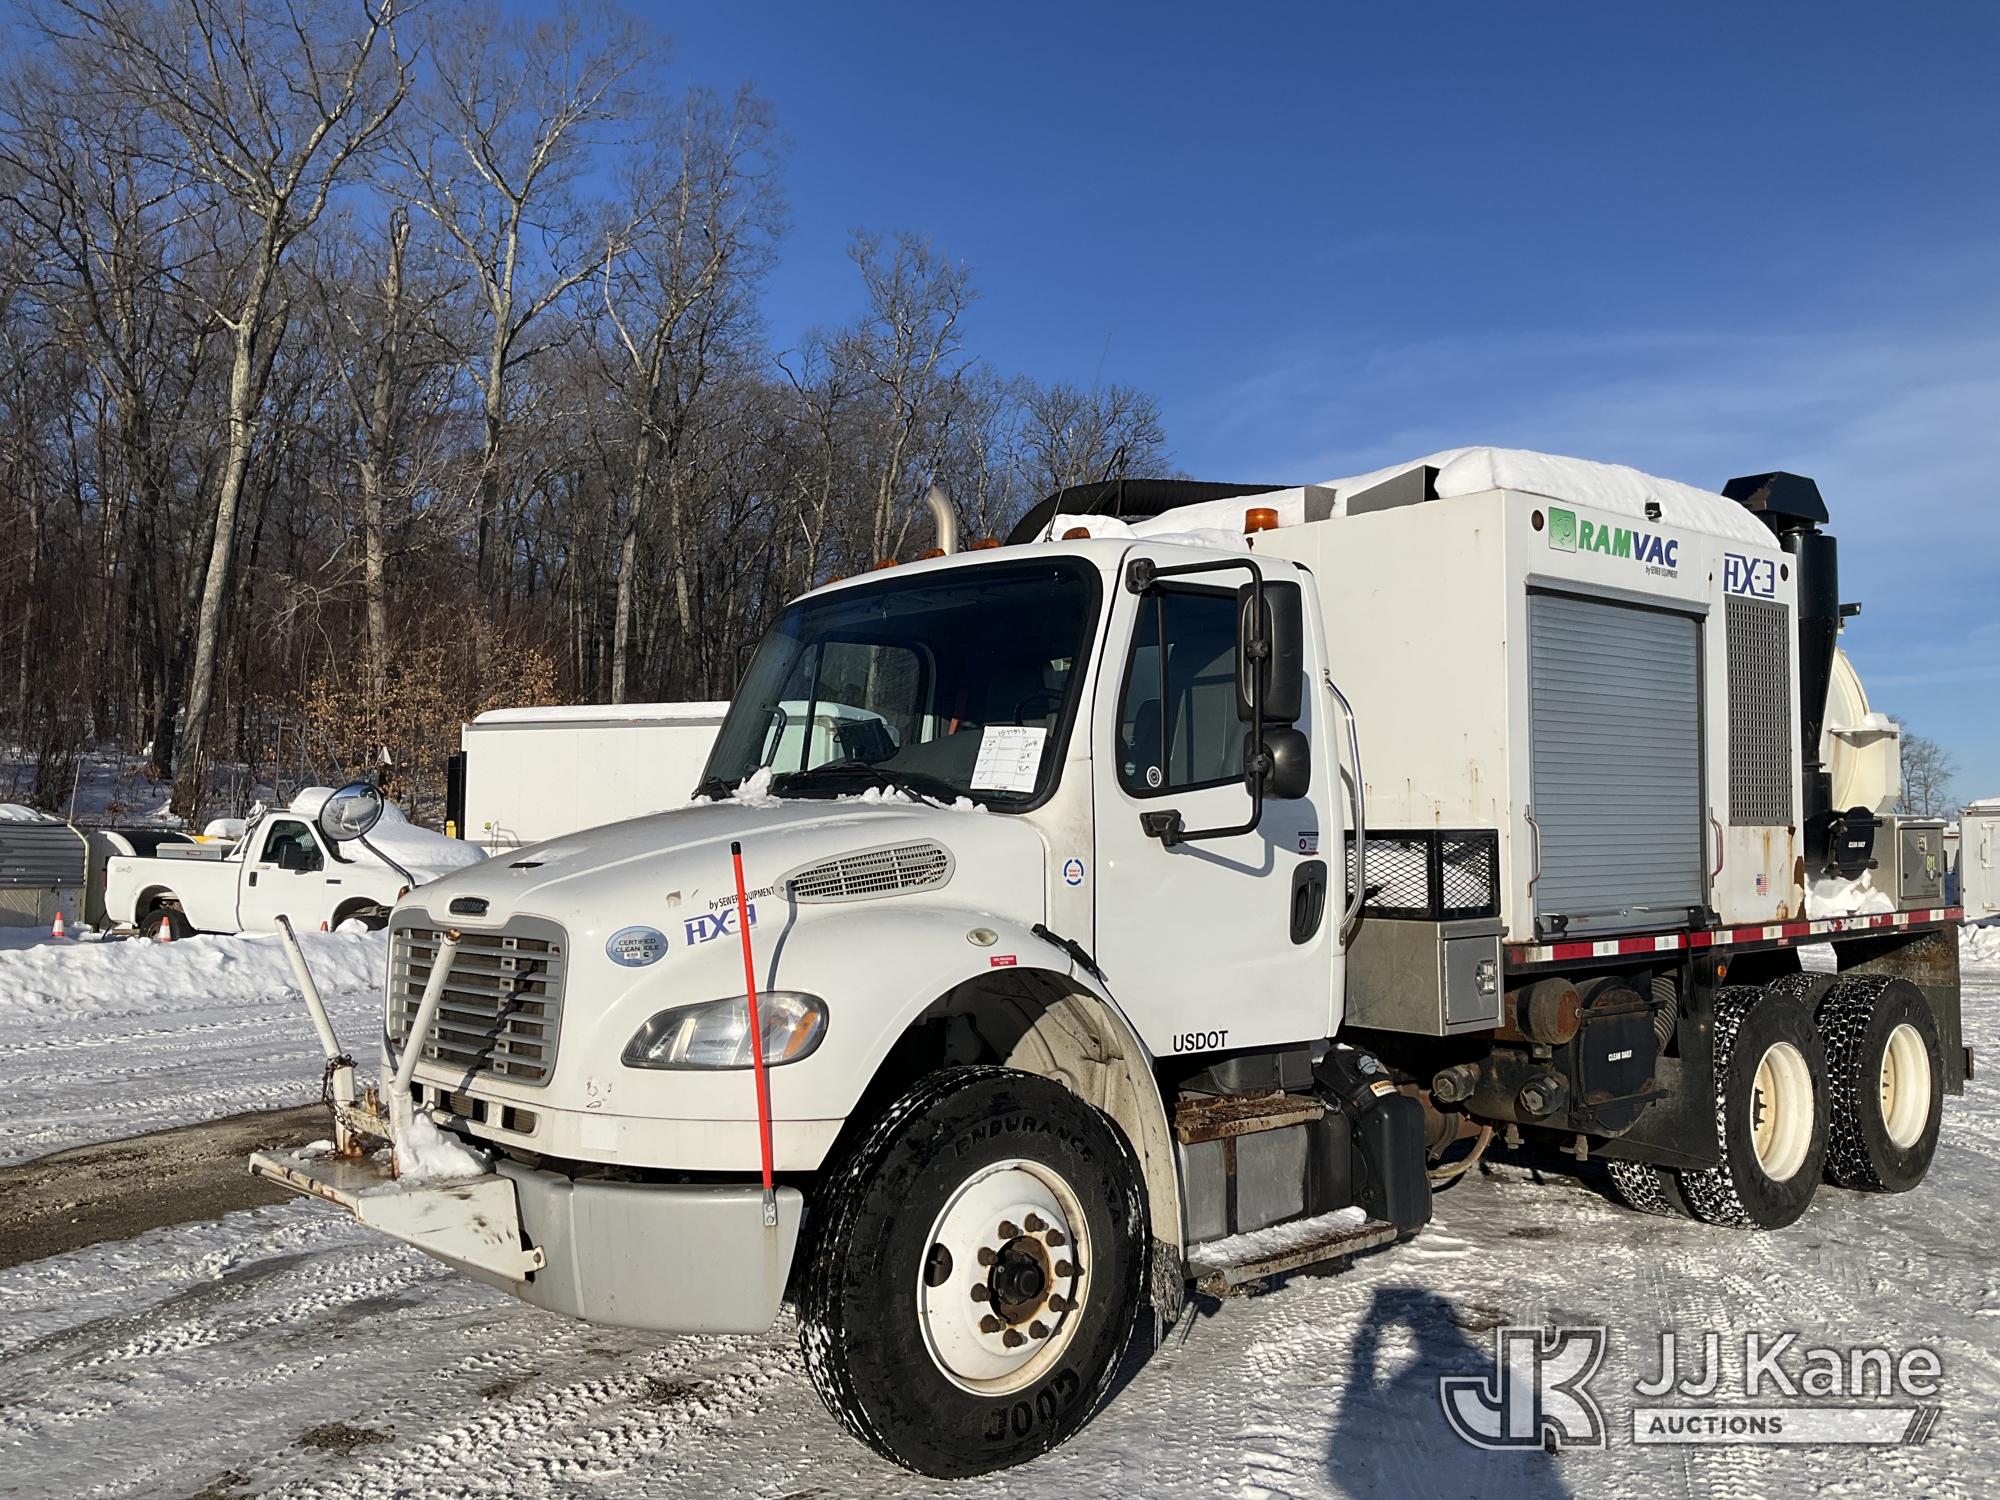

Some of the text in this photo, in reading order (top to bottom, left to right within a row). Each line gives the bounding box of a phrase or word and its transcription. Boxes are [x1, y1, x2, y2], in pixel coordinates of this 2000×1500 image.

[1579, 519, 1678, 568] RAMVAC
[1723, 552, 1775, 599] HX-3
[709, 899, 719, 911] by
[618, 938, 657, 946] CERTIFIED
[1172, 1030, 1229, 1052] USDOT
